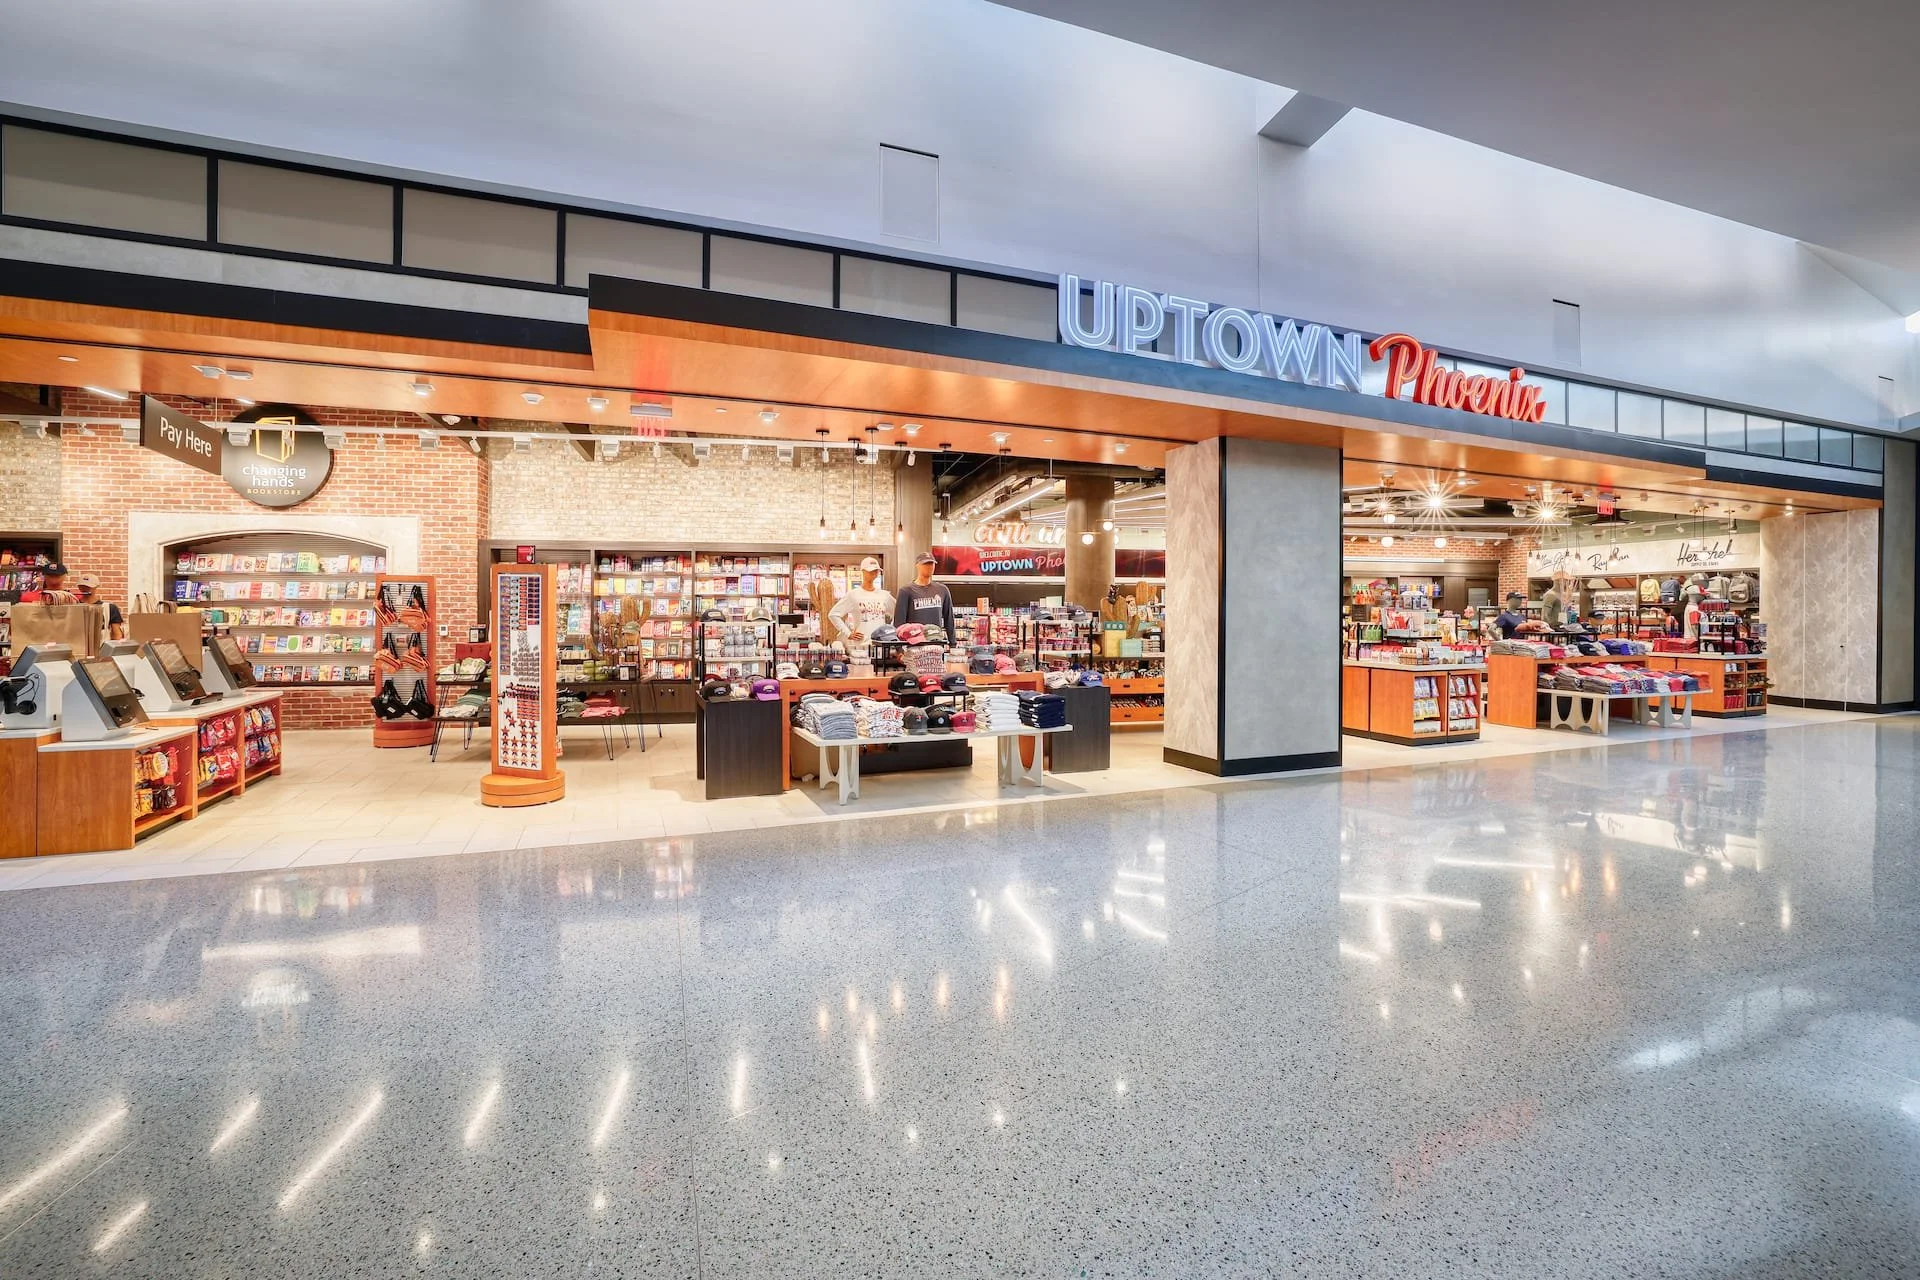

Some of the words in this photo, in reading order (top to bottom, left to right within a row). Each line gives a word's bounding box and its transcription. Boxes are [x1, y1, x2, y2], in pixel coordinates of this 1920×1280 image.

[1058, 272, 1364, 394] UPTOWN
[1369, 332, 1548, 424] Phoenix
[160, 416, 182, 449] Pay
[185, 428, 212, 457] Here
[242, 463, 306, 480] changing
[252, 475, 294, 487] hands
[980, 558, 1033, 572] UPTOWN
